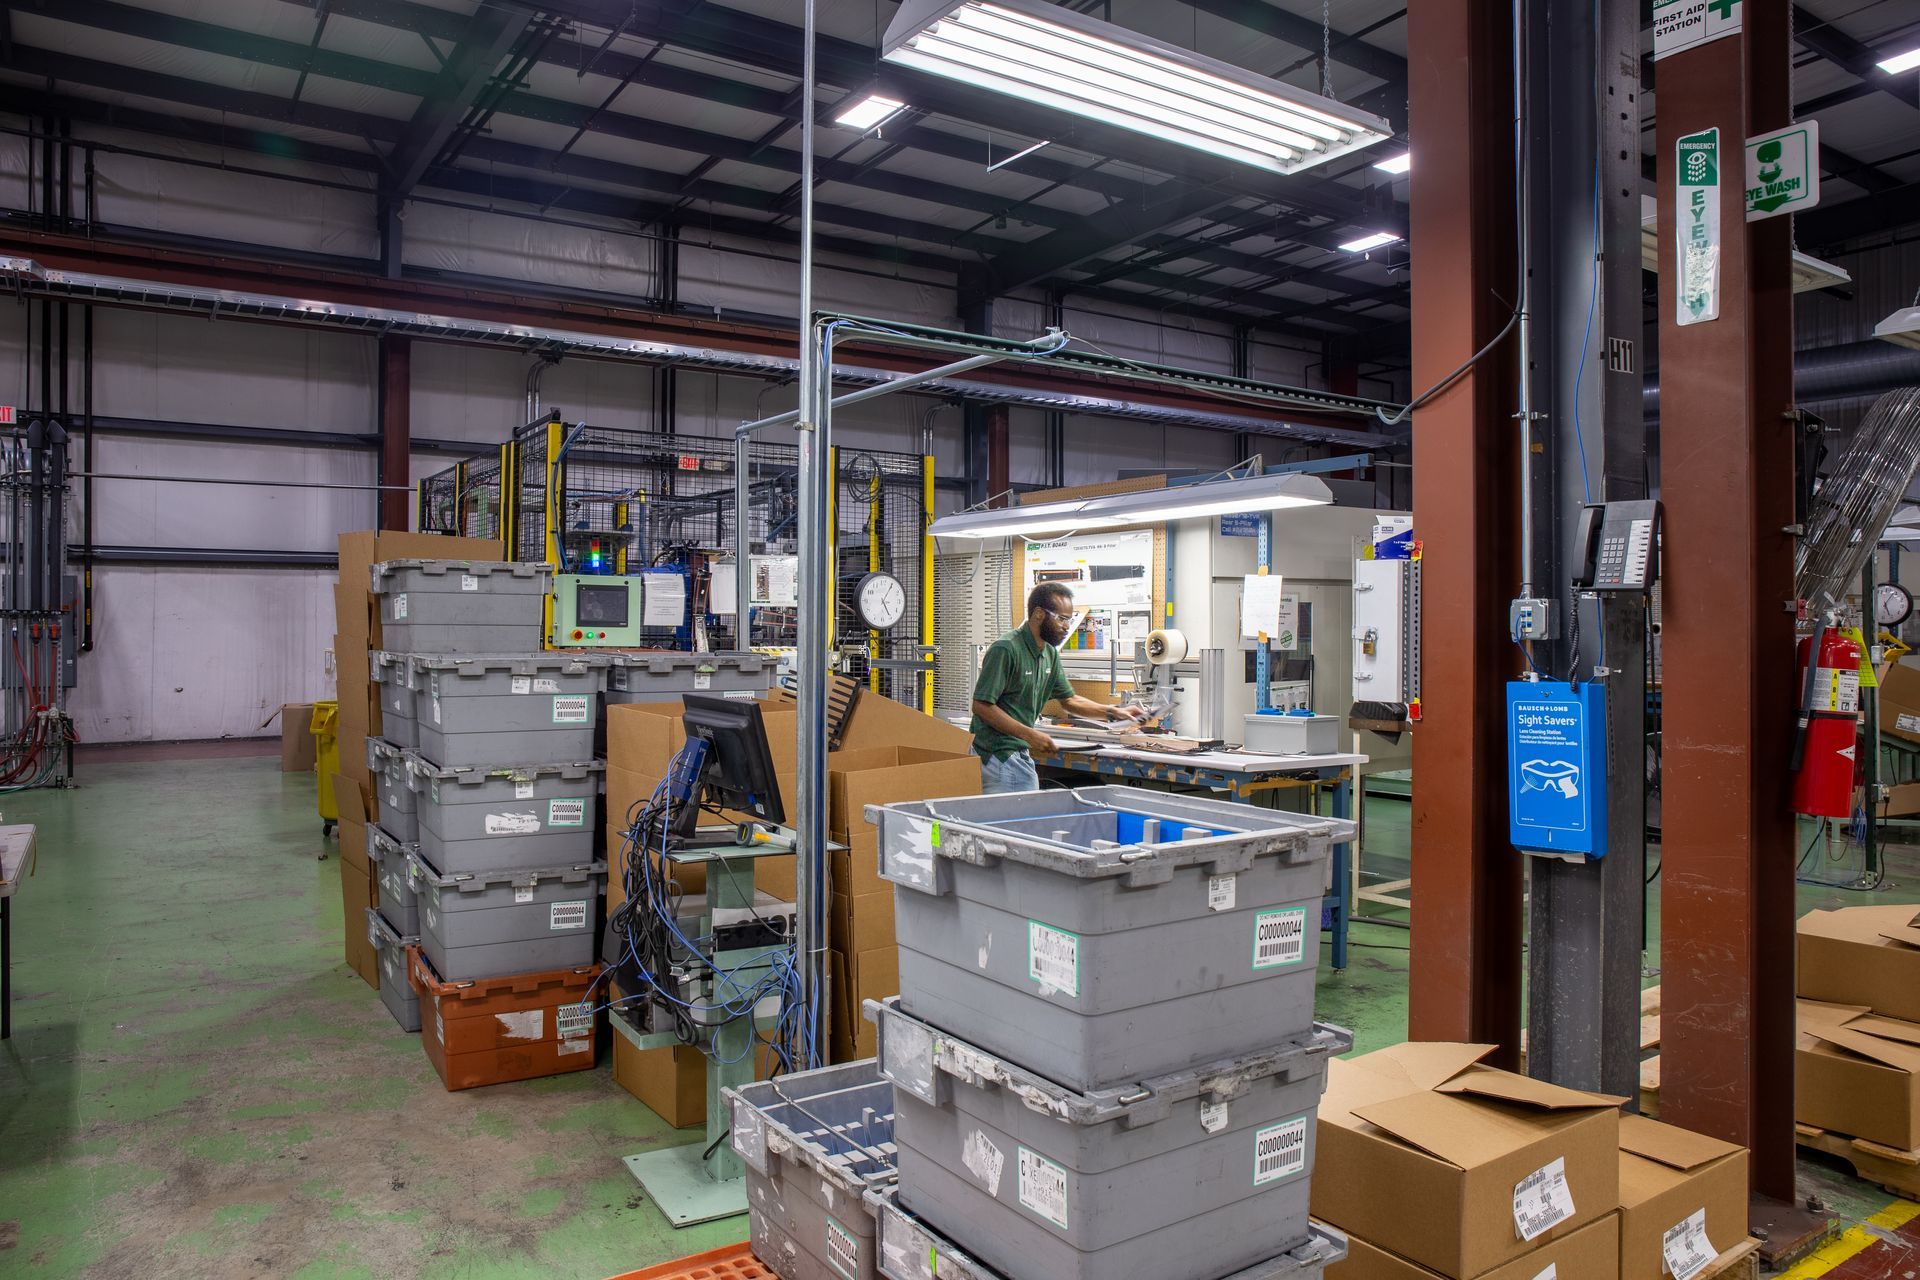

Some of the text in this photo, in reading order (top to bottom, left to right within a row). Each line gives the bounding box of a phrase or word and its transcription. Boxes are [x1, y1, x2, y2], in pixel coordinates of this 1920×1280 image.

[1654, 4, 1704, 26] FIRST AID
[1656, 15, 1702, 37] STATION
[1746, 177, 1800, 200] EYE WASH
[0, 407, 12, 422] IT
[1518, 714, 1576, 727] Sight Savers
[1259, 920, 1301, 940] C000000044
[1259, 1129, 1303, 1156] C000000044
